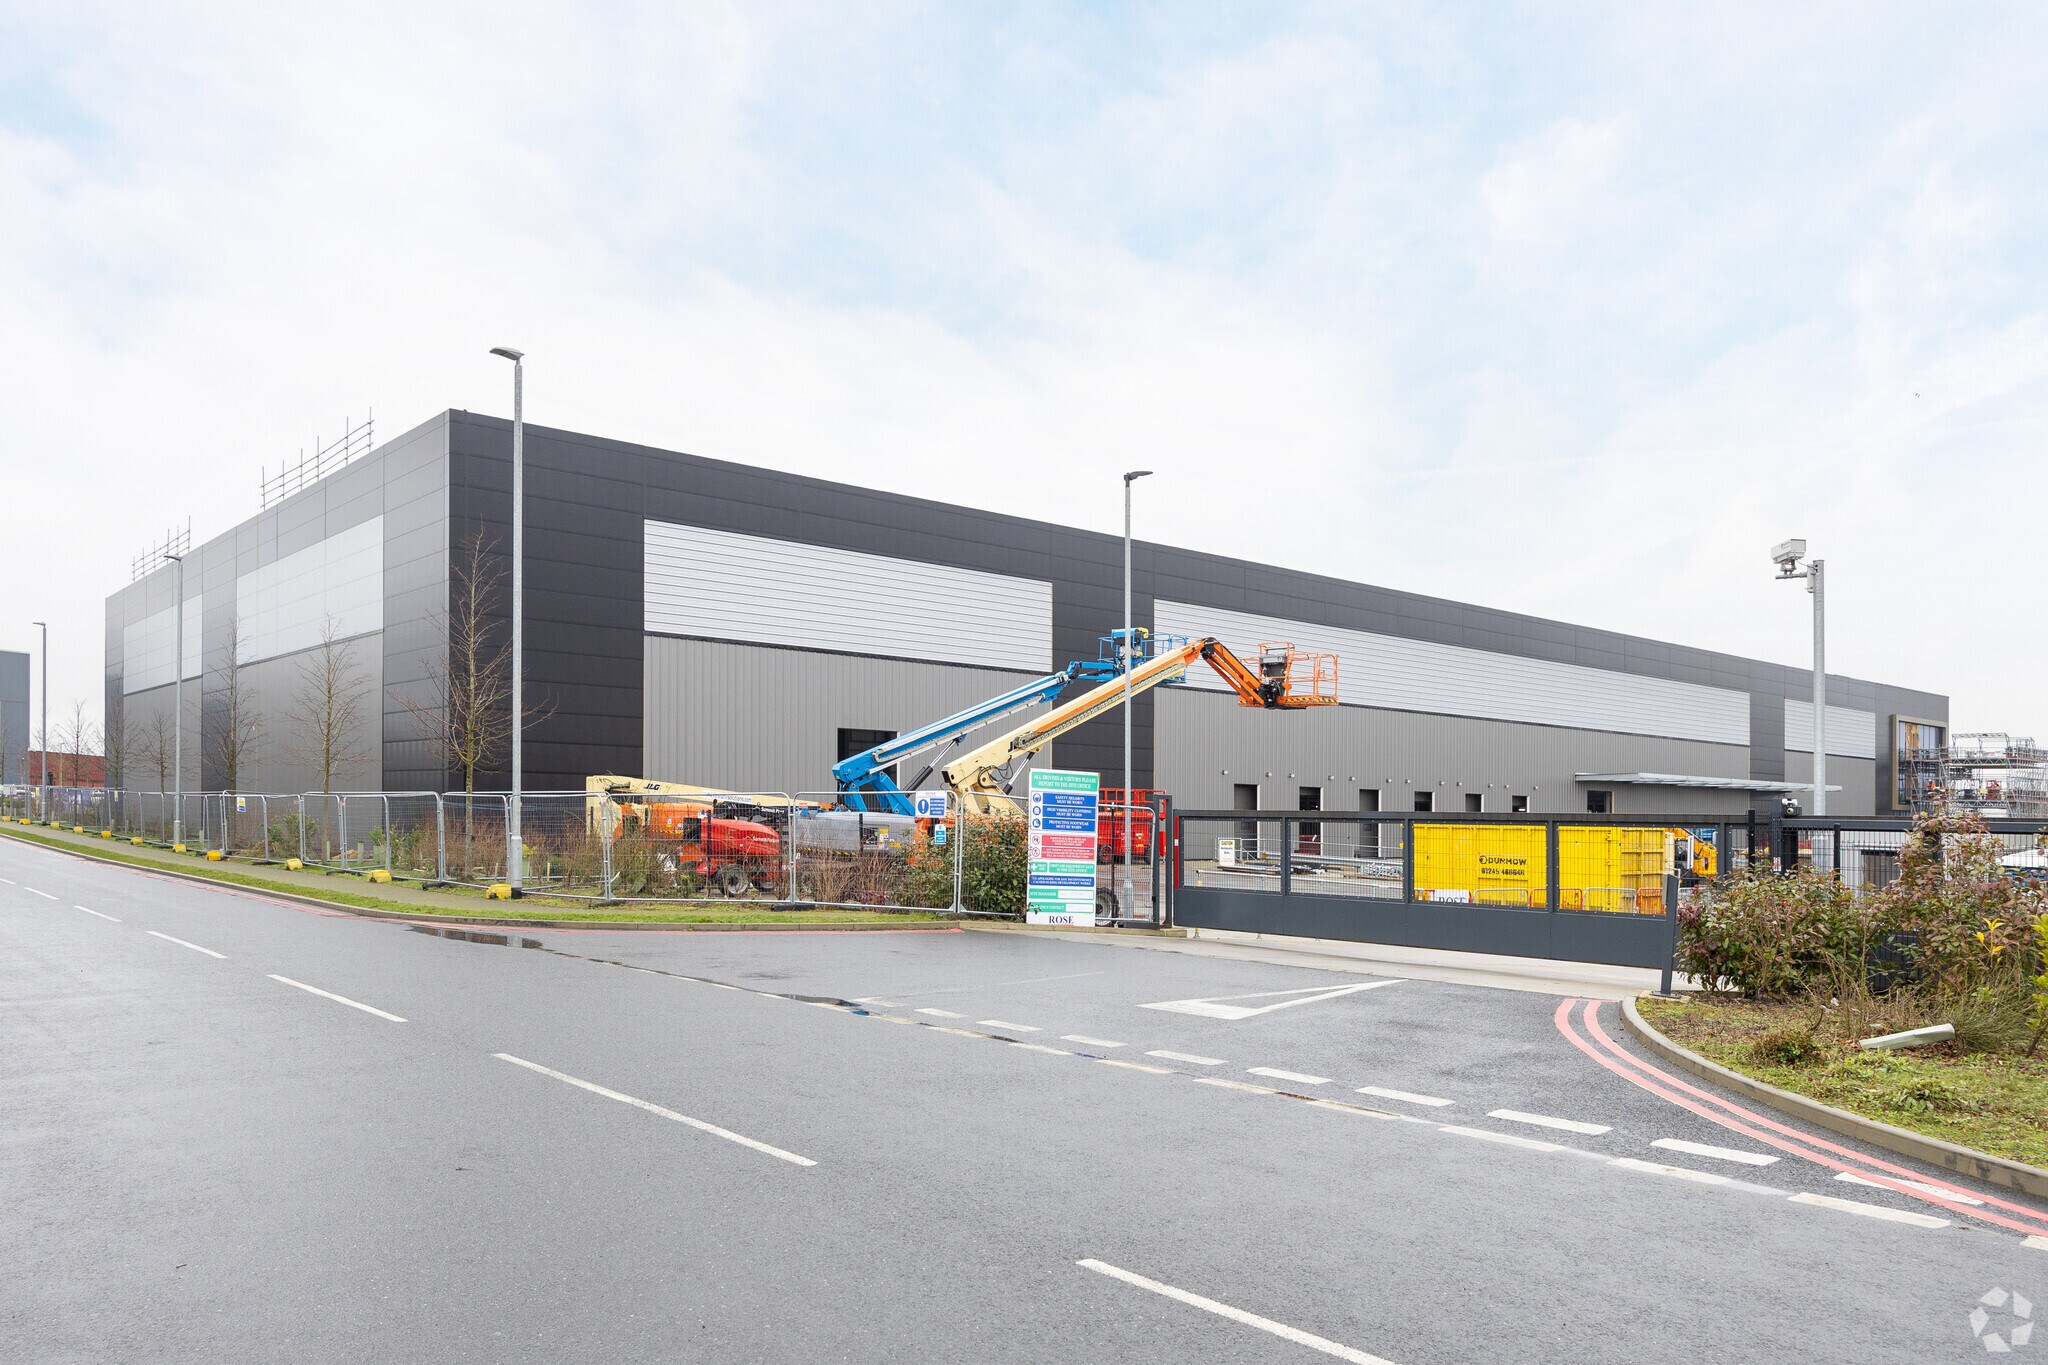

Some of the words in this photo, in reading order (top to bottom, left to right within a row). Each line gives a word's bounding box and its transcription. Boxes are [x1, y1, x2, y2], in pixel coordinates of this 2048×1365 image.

[644, 783, 660, 791] JLG
[1488, 857, 1527, 865] DUNMOW
[1481, 867, 1500, 875] 01245
[1049, 916, 1074, 924] ROSE
